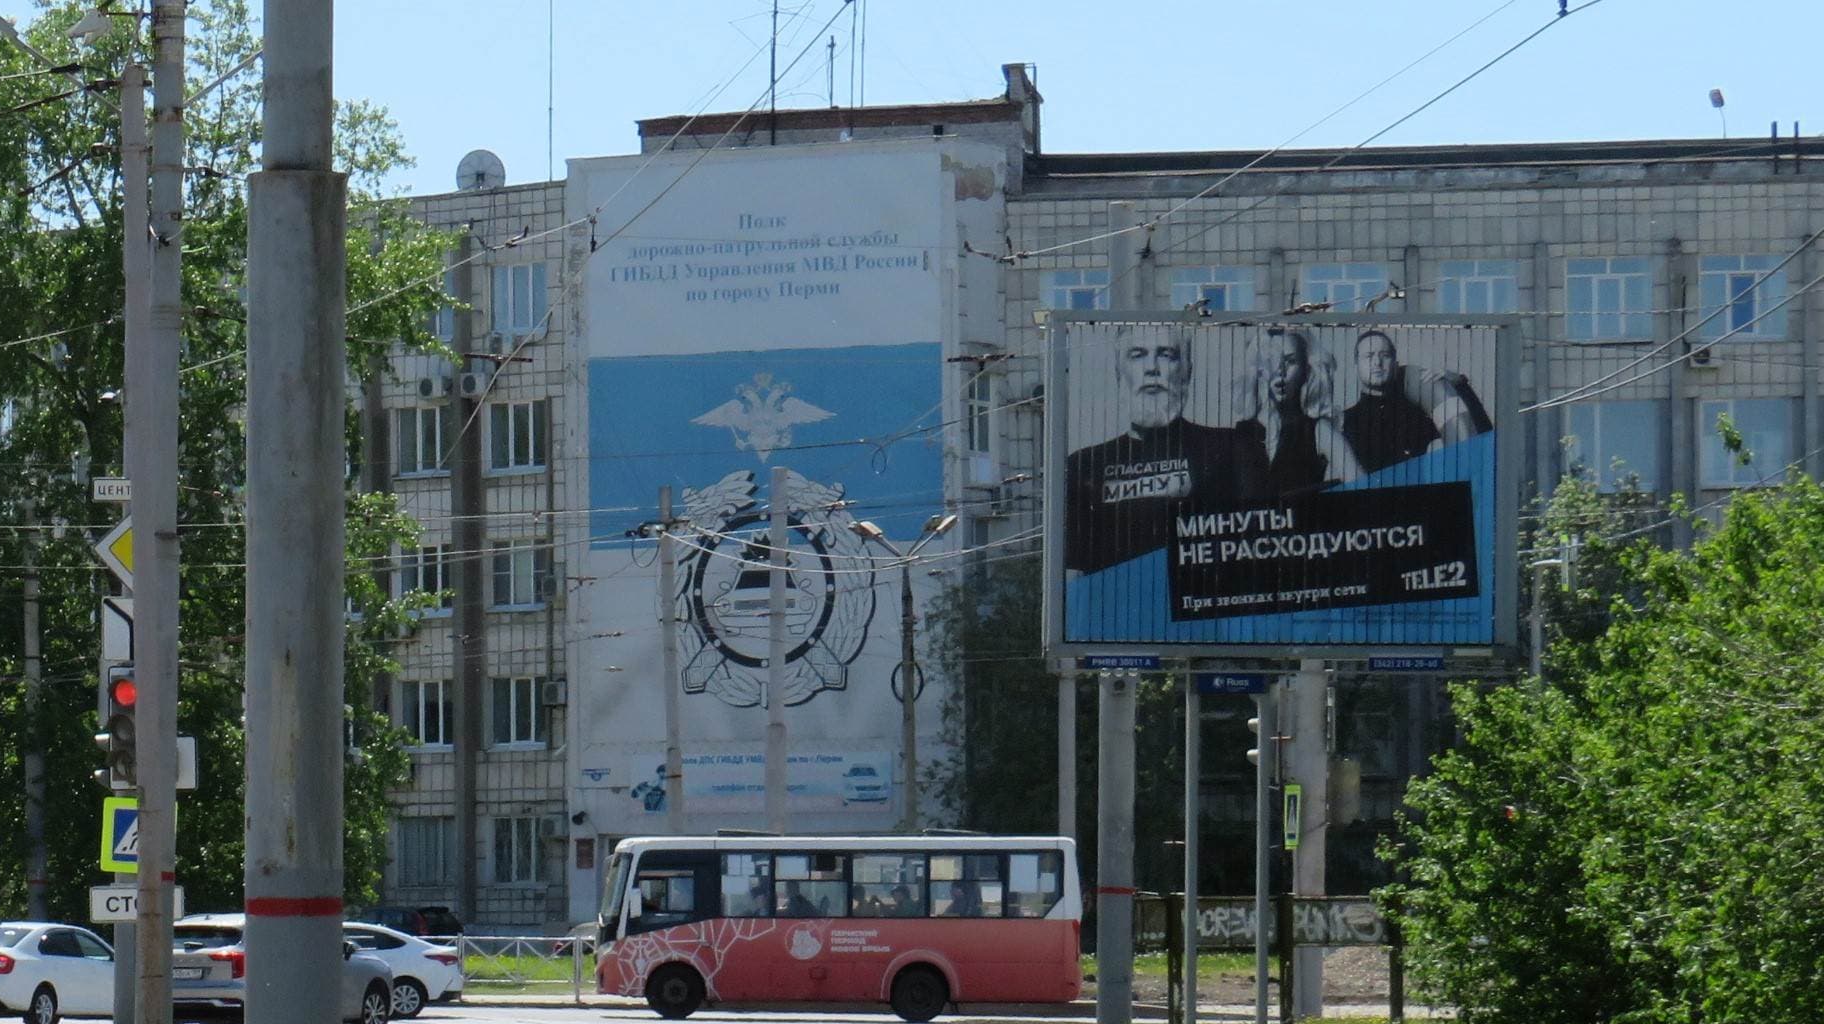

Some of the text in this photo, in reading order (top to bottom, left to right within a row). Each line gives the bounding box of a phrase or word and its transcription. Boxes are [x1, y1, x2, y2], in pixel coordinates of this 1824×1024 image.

[739, 213, 786, 231] Полк
[627, 231, 899, 262] дорожно-патрульной службы
[611, 253, 918, 284] ГИБДД Управления МВД России
[686, 281, 840, 304] по городу Перми
[1104, 458, 1188, 476] СПАСАТЕЛИ
[1104, 472, 1188, 501] МИНУТ
[1176, 508, 1293, 538] МИНУТЫ
[1179, 524, 1424, 566] НЕ РАСХОДУЮТСЯ
[1401, 561, 1466, 591] TELE2
[1182, 583, 1367, 611] При звонках внутри сети
[106, 896, 138, 913] СТ
